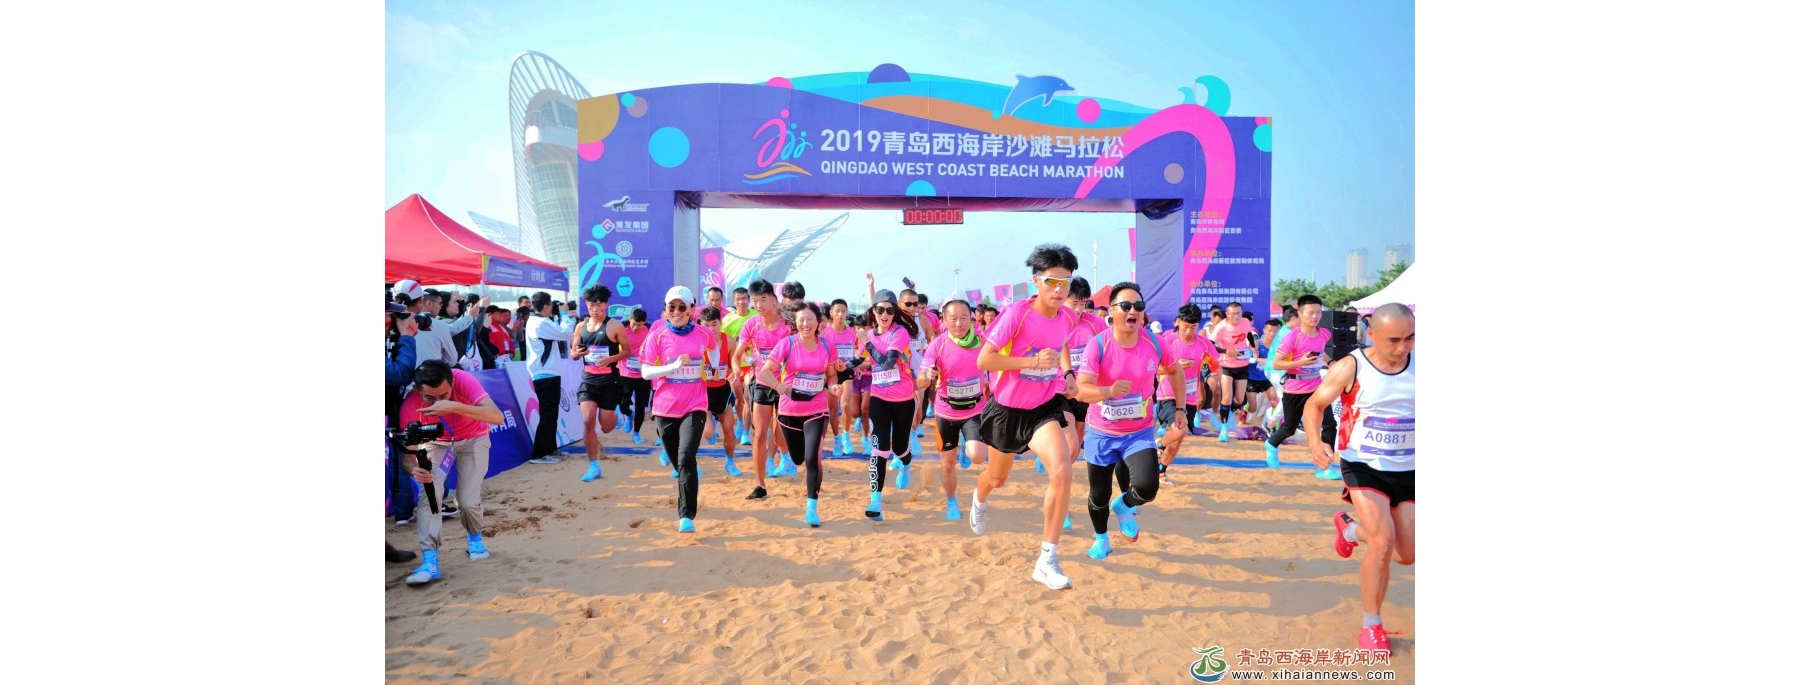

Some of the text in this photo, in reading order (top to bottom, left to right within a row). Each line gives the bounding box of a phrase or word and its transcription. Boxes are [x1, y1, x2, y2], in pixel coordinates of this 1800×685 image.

[820, 128, 1124, 159] 2019青岛西海岸沙滩马拉松
[821, 160, 1125, 179] QINGDAO WEST COAST BEACH MARATHON
[906, 210, 962, 223] 00:00:00
[948, 387, 974, 395] C5278
[1103, 406, 1134, 417] A0626
[1364, 430, 1407, 444] A0881
